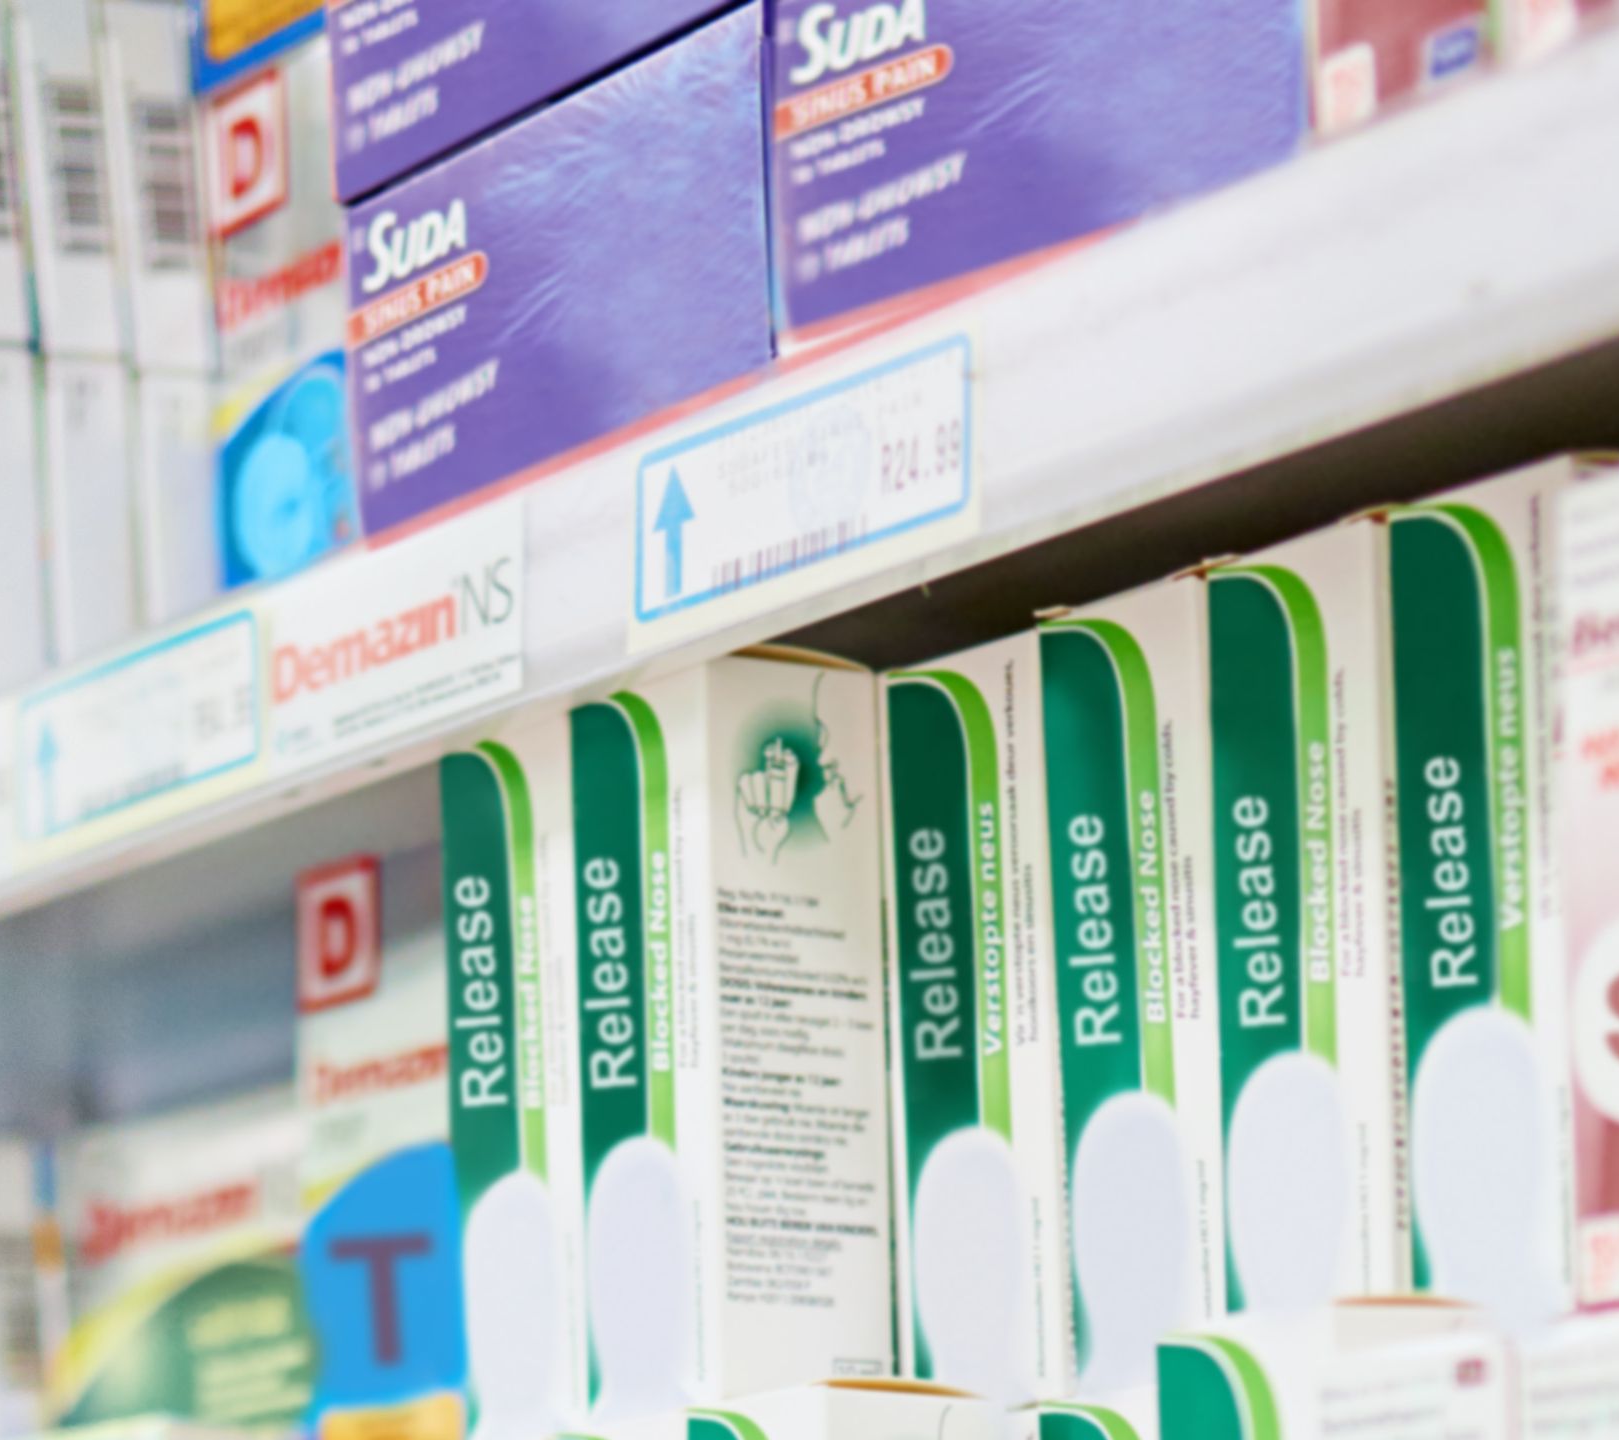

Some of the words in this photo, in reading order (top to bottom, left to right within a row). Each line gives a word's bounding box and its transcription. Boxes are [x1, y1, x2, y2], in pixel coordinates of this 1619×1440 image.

[789, 0, 926, 83] SUDA
[872, 60, 936, 94] PAIN
[228, 115, 262, 198] D
[362, 199, 466, 292] SUDA
[426, 261, 476, 302] PAIN
[881, 419, 960, 495] R24.99
[272, 593, 455, 706] Demazin
[1495, 647, 1518, 738] neus
[1005, 742, 1016, 780] deur
[1306, 741, 1328, 831] Nose
[976, 802, 997, 882] neus
[1136, 790, 1159, 877] Nose
[1165, 798, 1178, 858] caused
[1423, 756, 1479, 989] Release
[1498, 743, 1526, 931] Verstopte
[647, 851, 668, 932] Nose
[1170, 862, 1180, 903] nose
[1232, 796, 1286, 1027] Release
[1305, 840, 1330, 985] Blocked
[318, 895, 356, 980] D
[518, 895, 539, 975] Nose
[583, 858, 637, 1089] Release
[908, 829, 963, 1061] Release
[980, 890, 1003, 1056] Verstopte
[1067, 814, 1122, 1046] Release
[1139, 886, 1166, 1023] Blocked
[1169, 906, 1183, 975] blocked
[454, 876, 507, 1107] Release
[648, 941, 672, 1072] Blocked
[1174, 991, 1186, 1019] For
[1186, 946, 1202, 1019] hayfever
[519, 980, 542, 1109] Blocked
[326, 1230, 433, 1367] T
